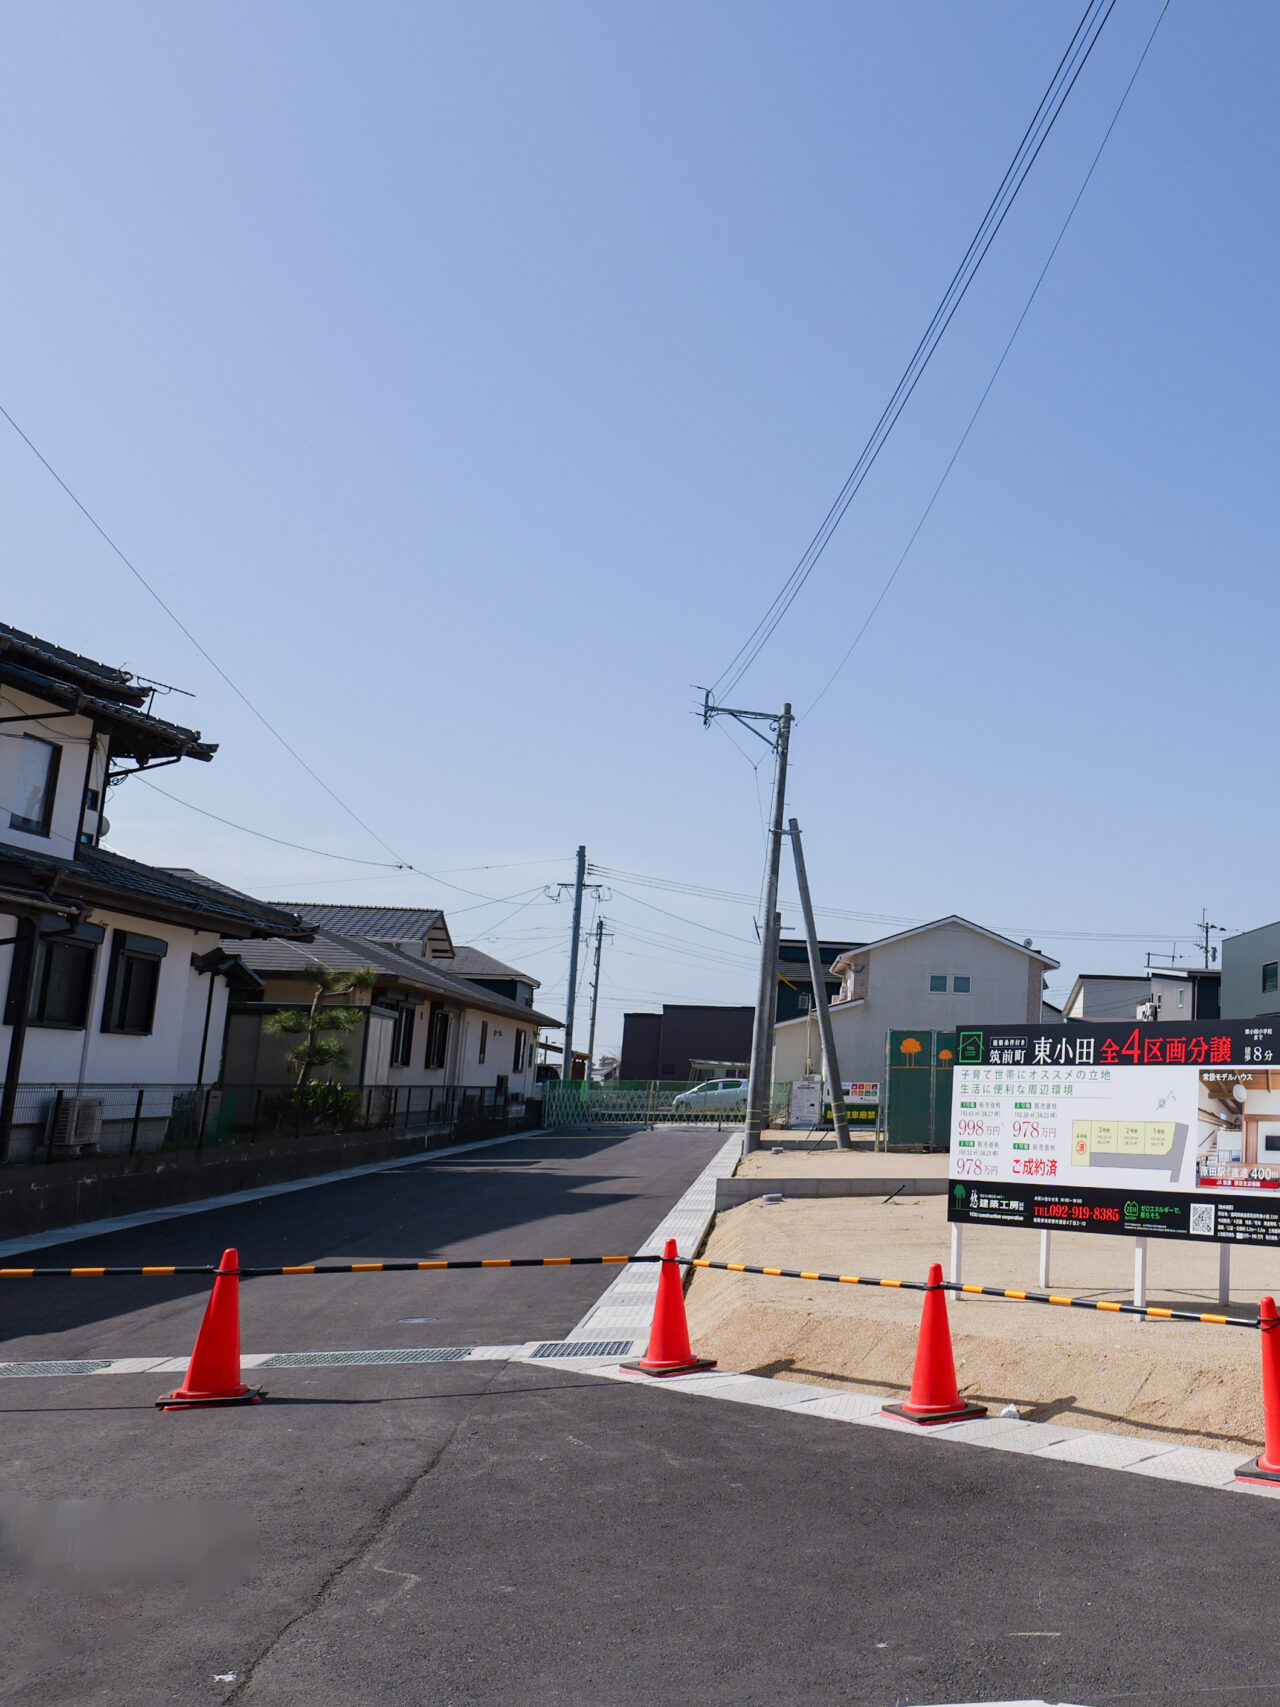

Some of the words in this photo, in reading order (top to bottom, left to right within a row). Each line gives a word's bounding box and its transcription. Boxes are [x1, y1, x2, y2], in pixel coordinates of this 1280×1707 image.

[1032, 1036, 1095, 1064] 東小田
[1100, 1028, 1232, 1063] 全4区画分譲
[989, 1050, 1026, 1064] 筑前町
[960, 1069, 1111, 1081] 子育て世帯にオススメの立地
[1203, 1073, 1253, 1081] 常設モデルハウス
[960, 1084, 1074, 1095] 生活に便利な周辺環境
[958, 1119, 1000, 1136] 998万円
[1012, 1121, 1056, 1138] 978万円
[956, 1158, 998, 1176] 978万円
[1012, 1159, 1058, 1176] ご成約済
[979, 1199, 1019, 1210] 建築工房
